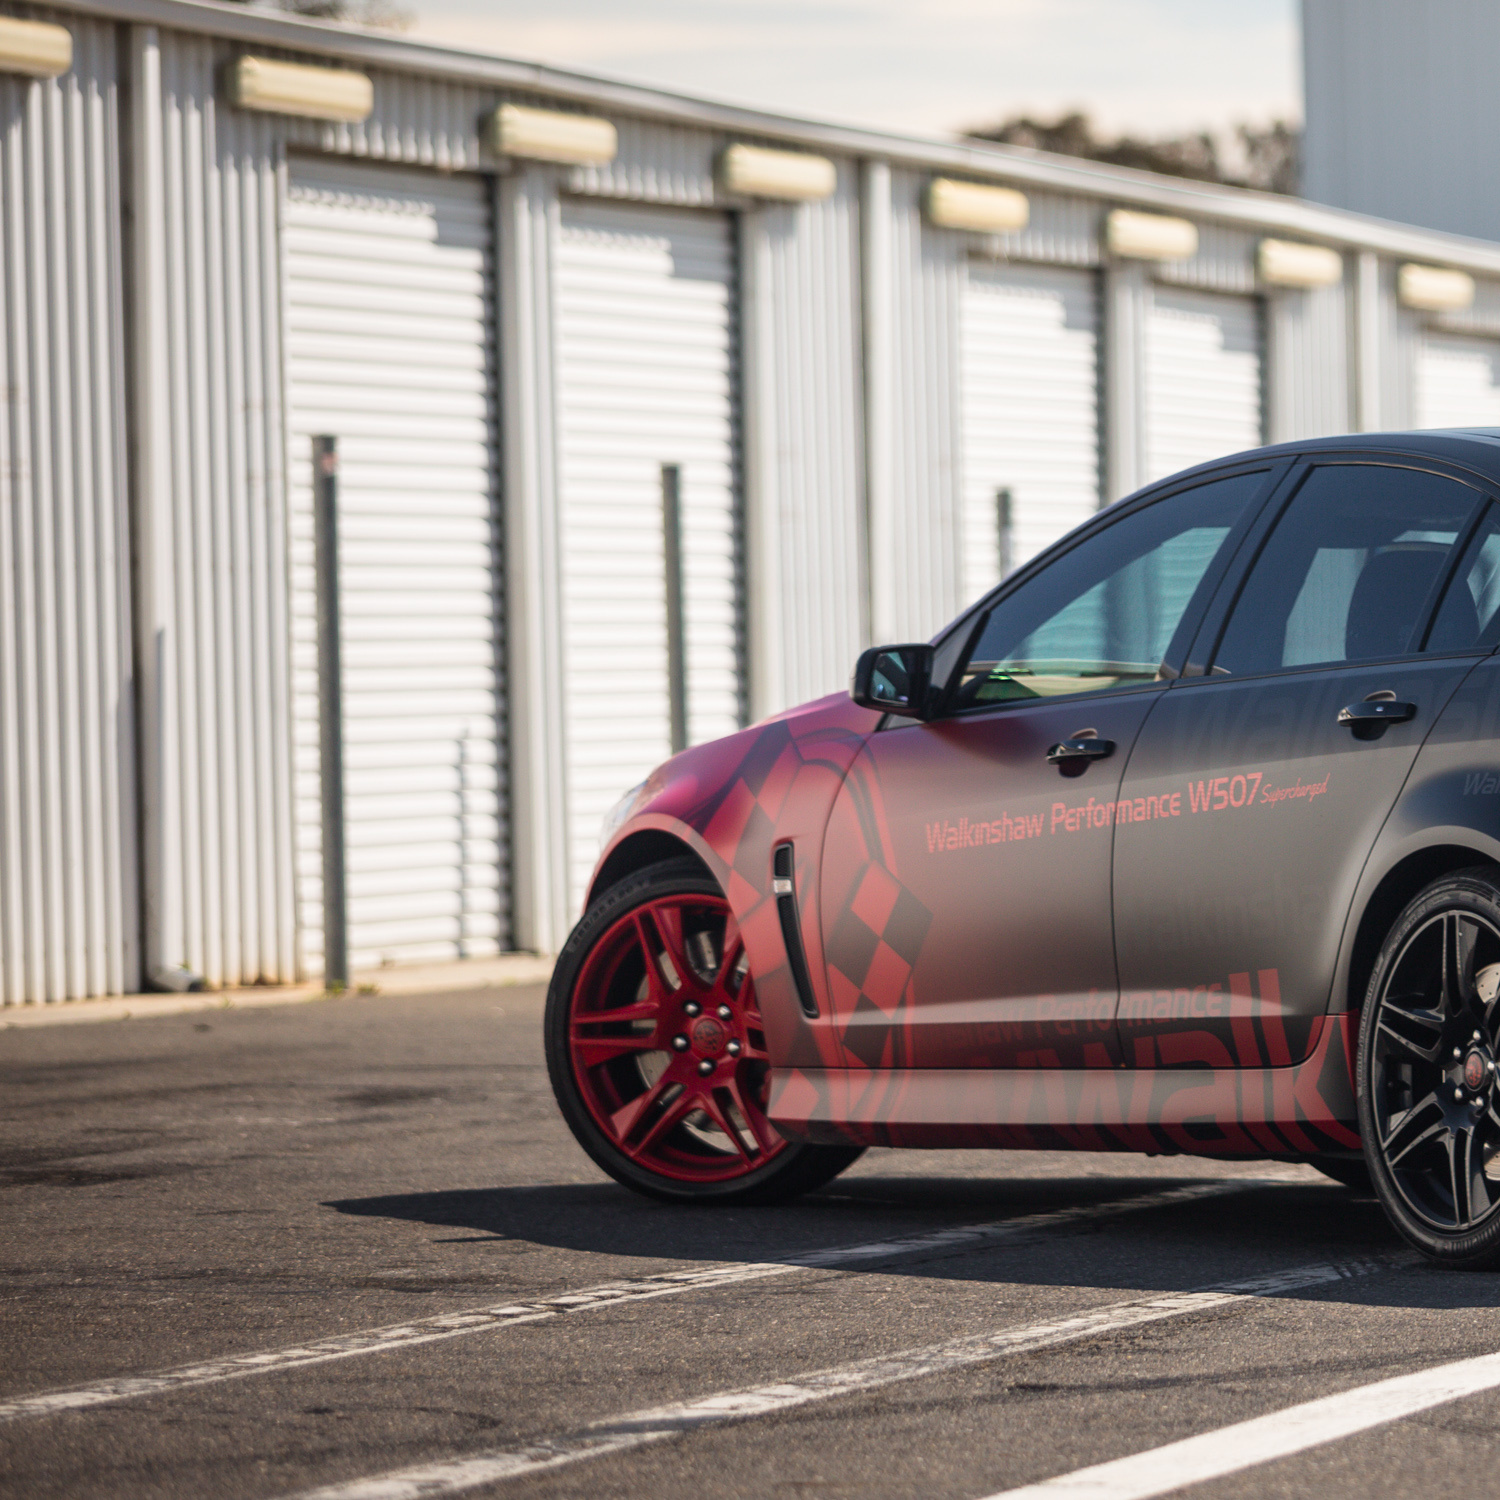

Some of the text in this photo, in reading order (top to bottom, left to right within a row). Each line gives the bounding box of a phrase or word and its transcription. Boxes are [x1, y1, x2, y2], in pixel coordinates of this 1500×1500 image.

[926, 811, 1044, 853] Walkinshaw
[1051, 797, 1181, 835] Performance
[1188, 772, 1263, 813] W507
